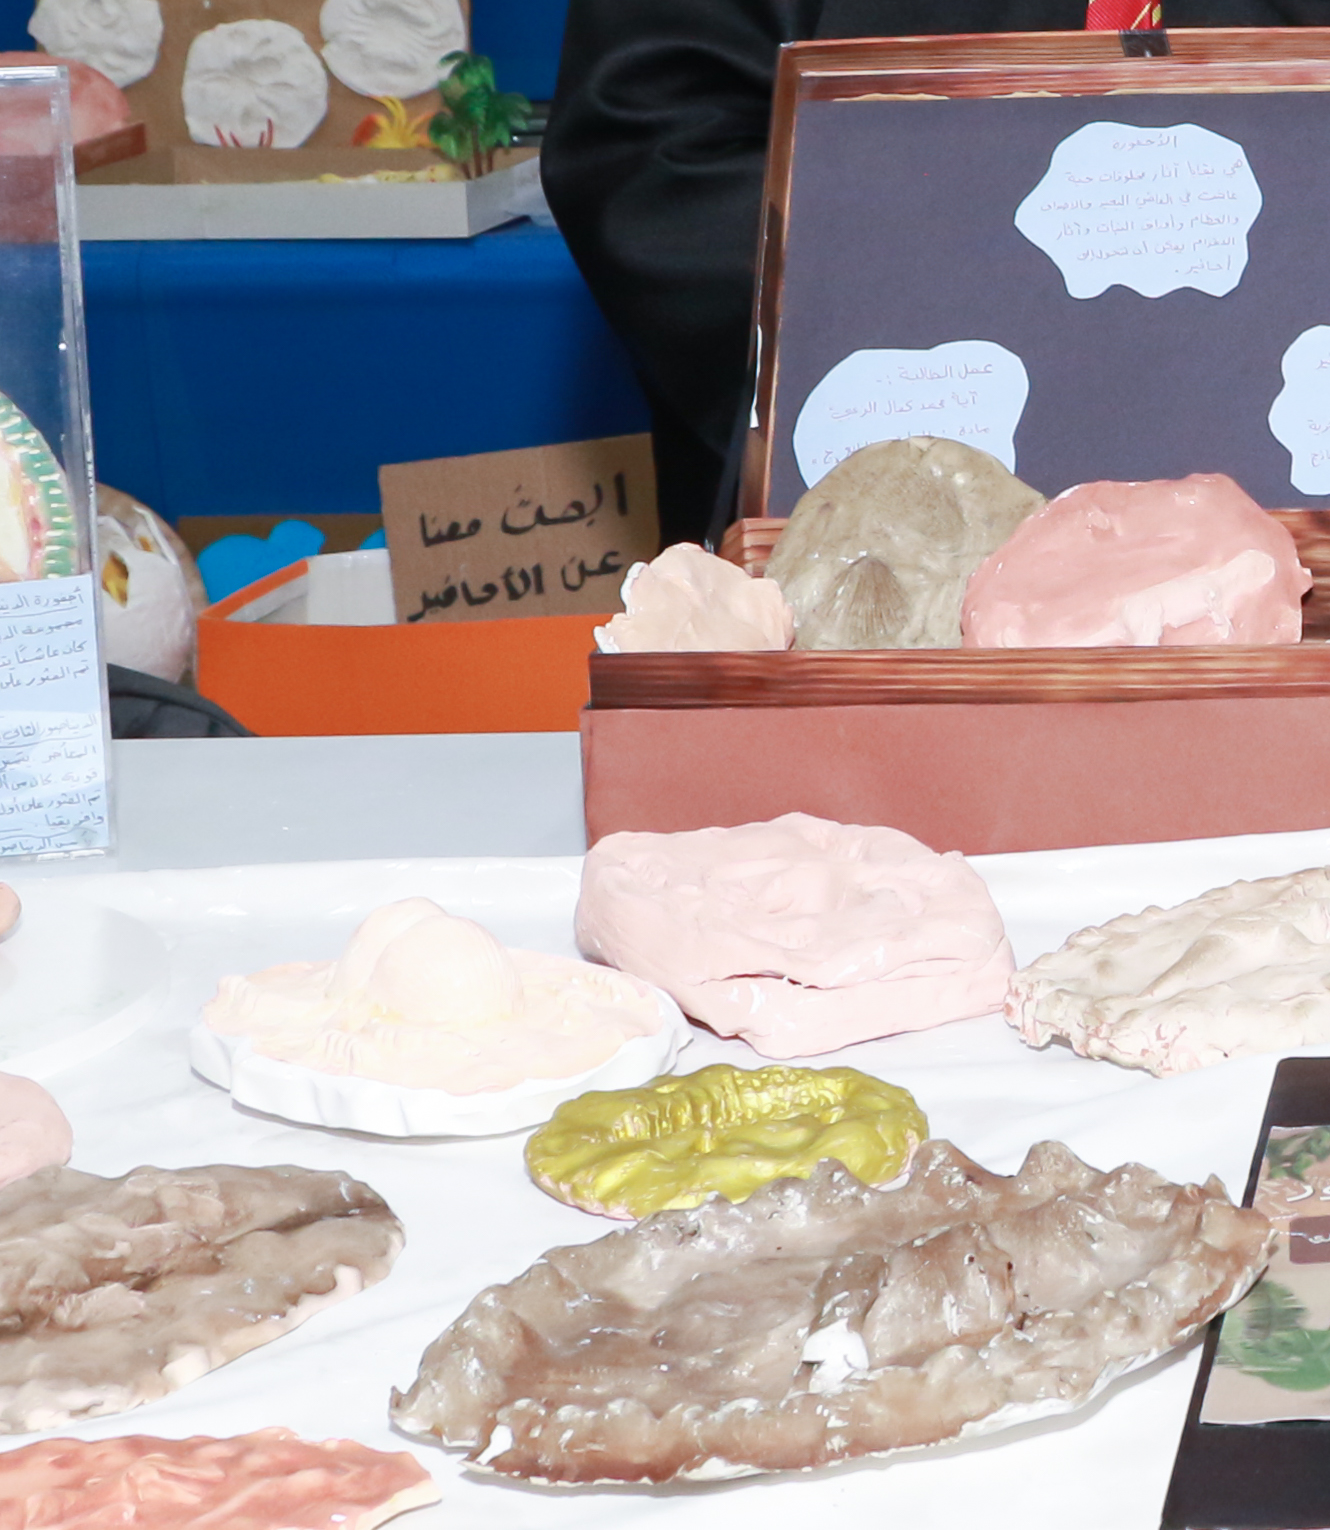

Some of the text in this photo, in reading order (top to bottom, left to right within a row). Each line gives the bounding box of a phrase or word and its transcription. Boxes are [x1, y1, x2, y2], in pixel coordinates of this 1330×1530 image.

[957, 363, 994, 381] عمل
[419, 512, 482, 548] معنا
[560, 550, 624, 592] عن
